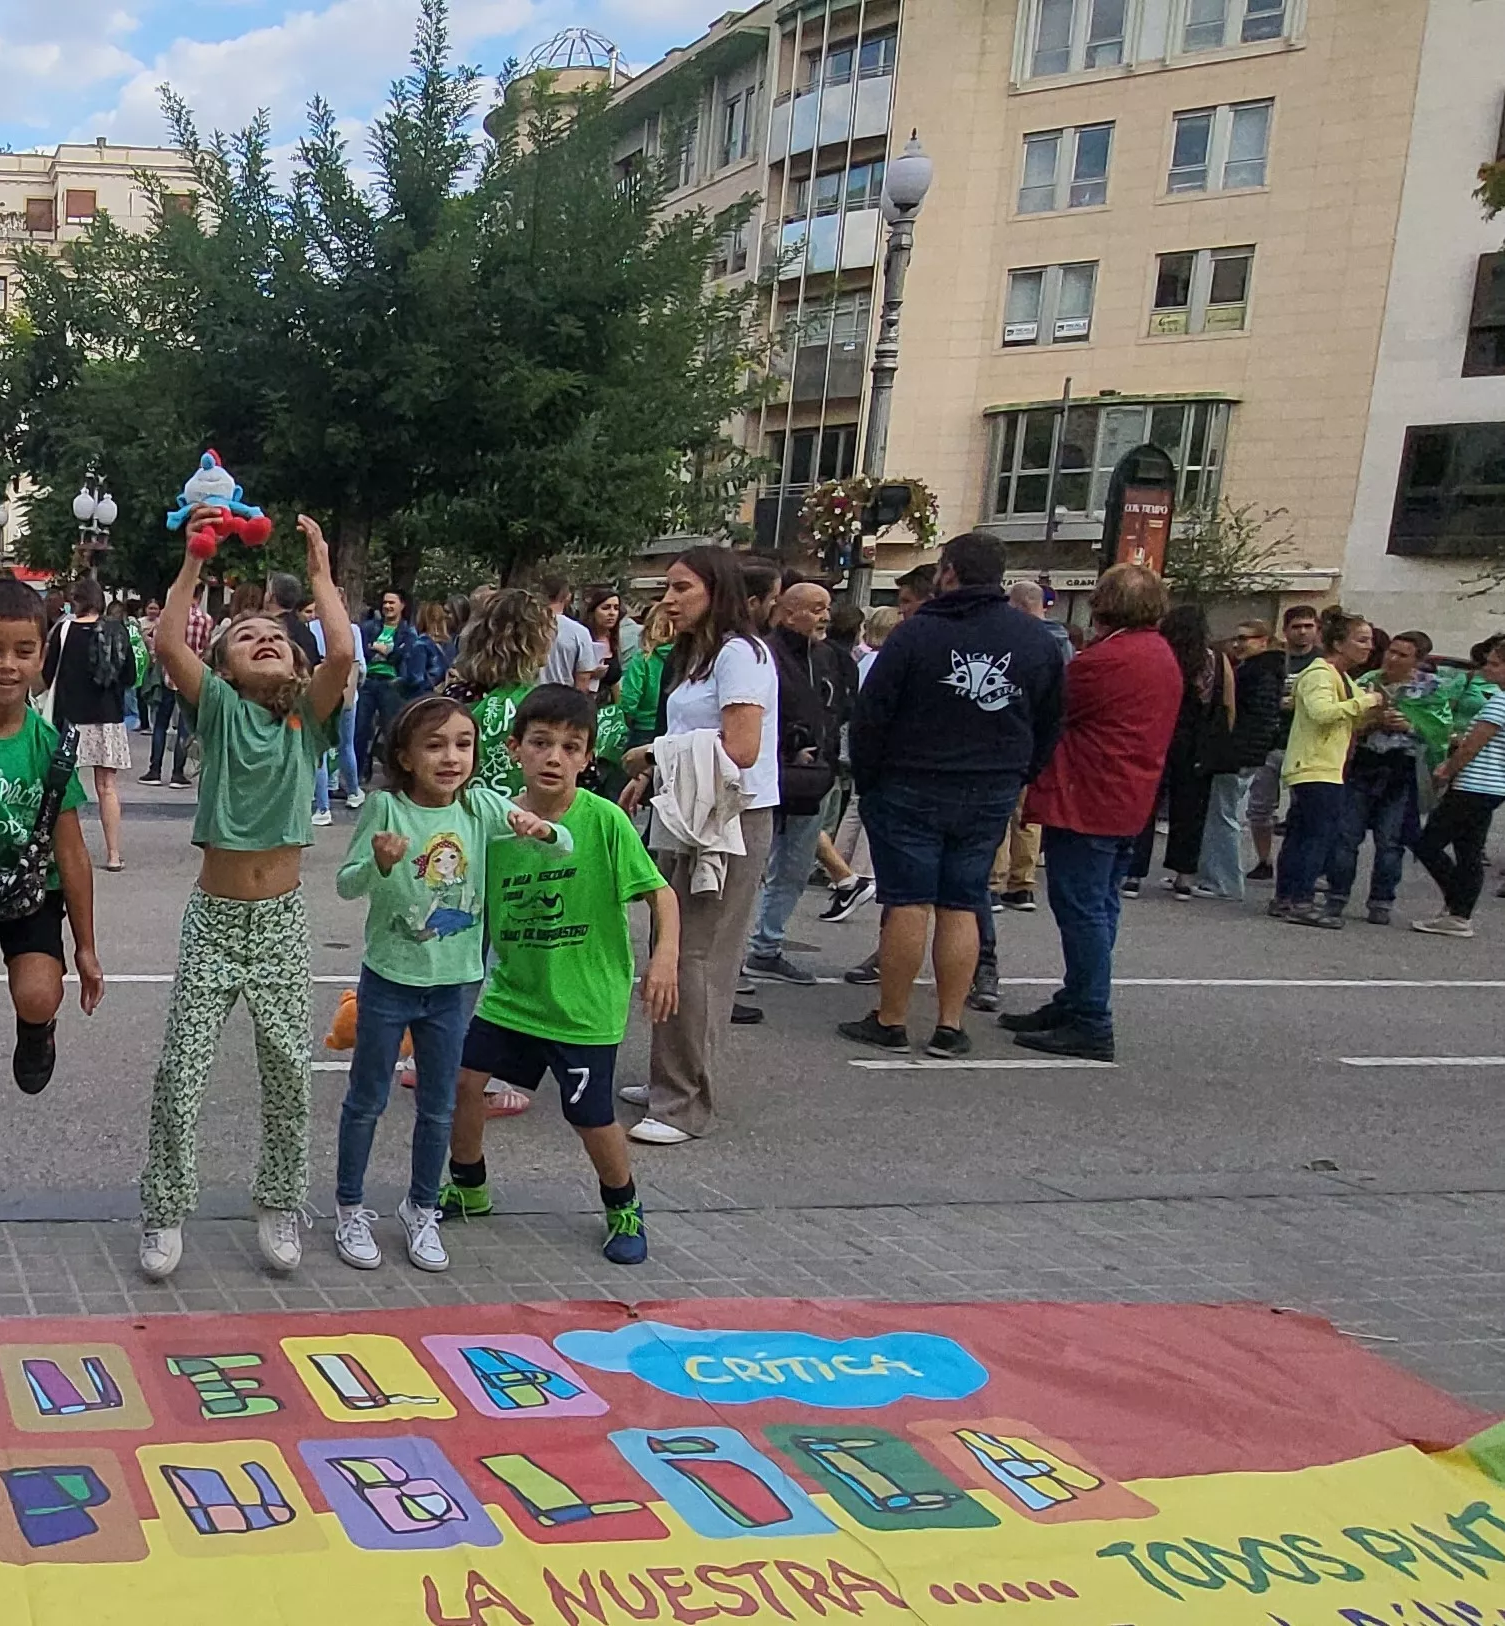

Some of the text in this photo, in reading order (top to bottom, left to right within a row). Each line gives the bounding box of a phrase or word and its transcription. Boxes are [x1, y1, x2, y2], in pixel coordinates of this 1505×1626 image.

[567, 1067, 590, 1104] 7
[685, 1351, 925, 1384] CRÍTICA
[422, 1569, 535, 1626] LA
[542, 1558, 911, 1626] NUESTRA
[1096, 1533, 1366, 1602] TODOS
